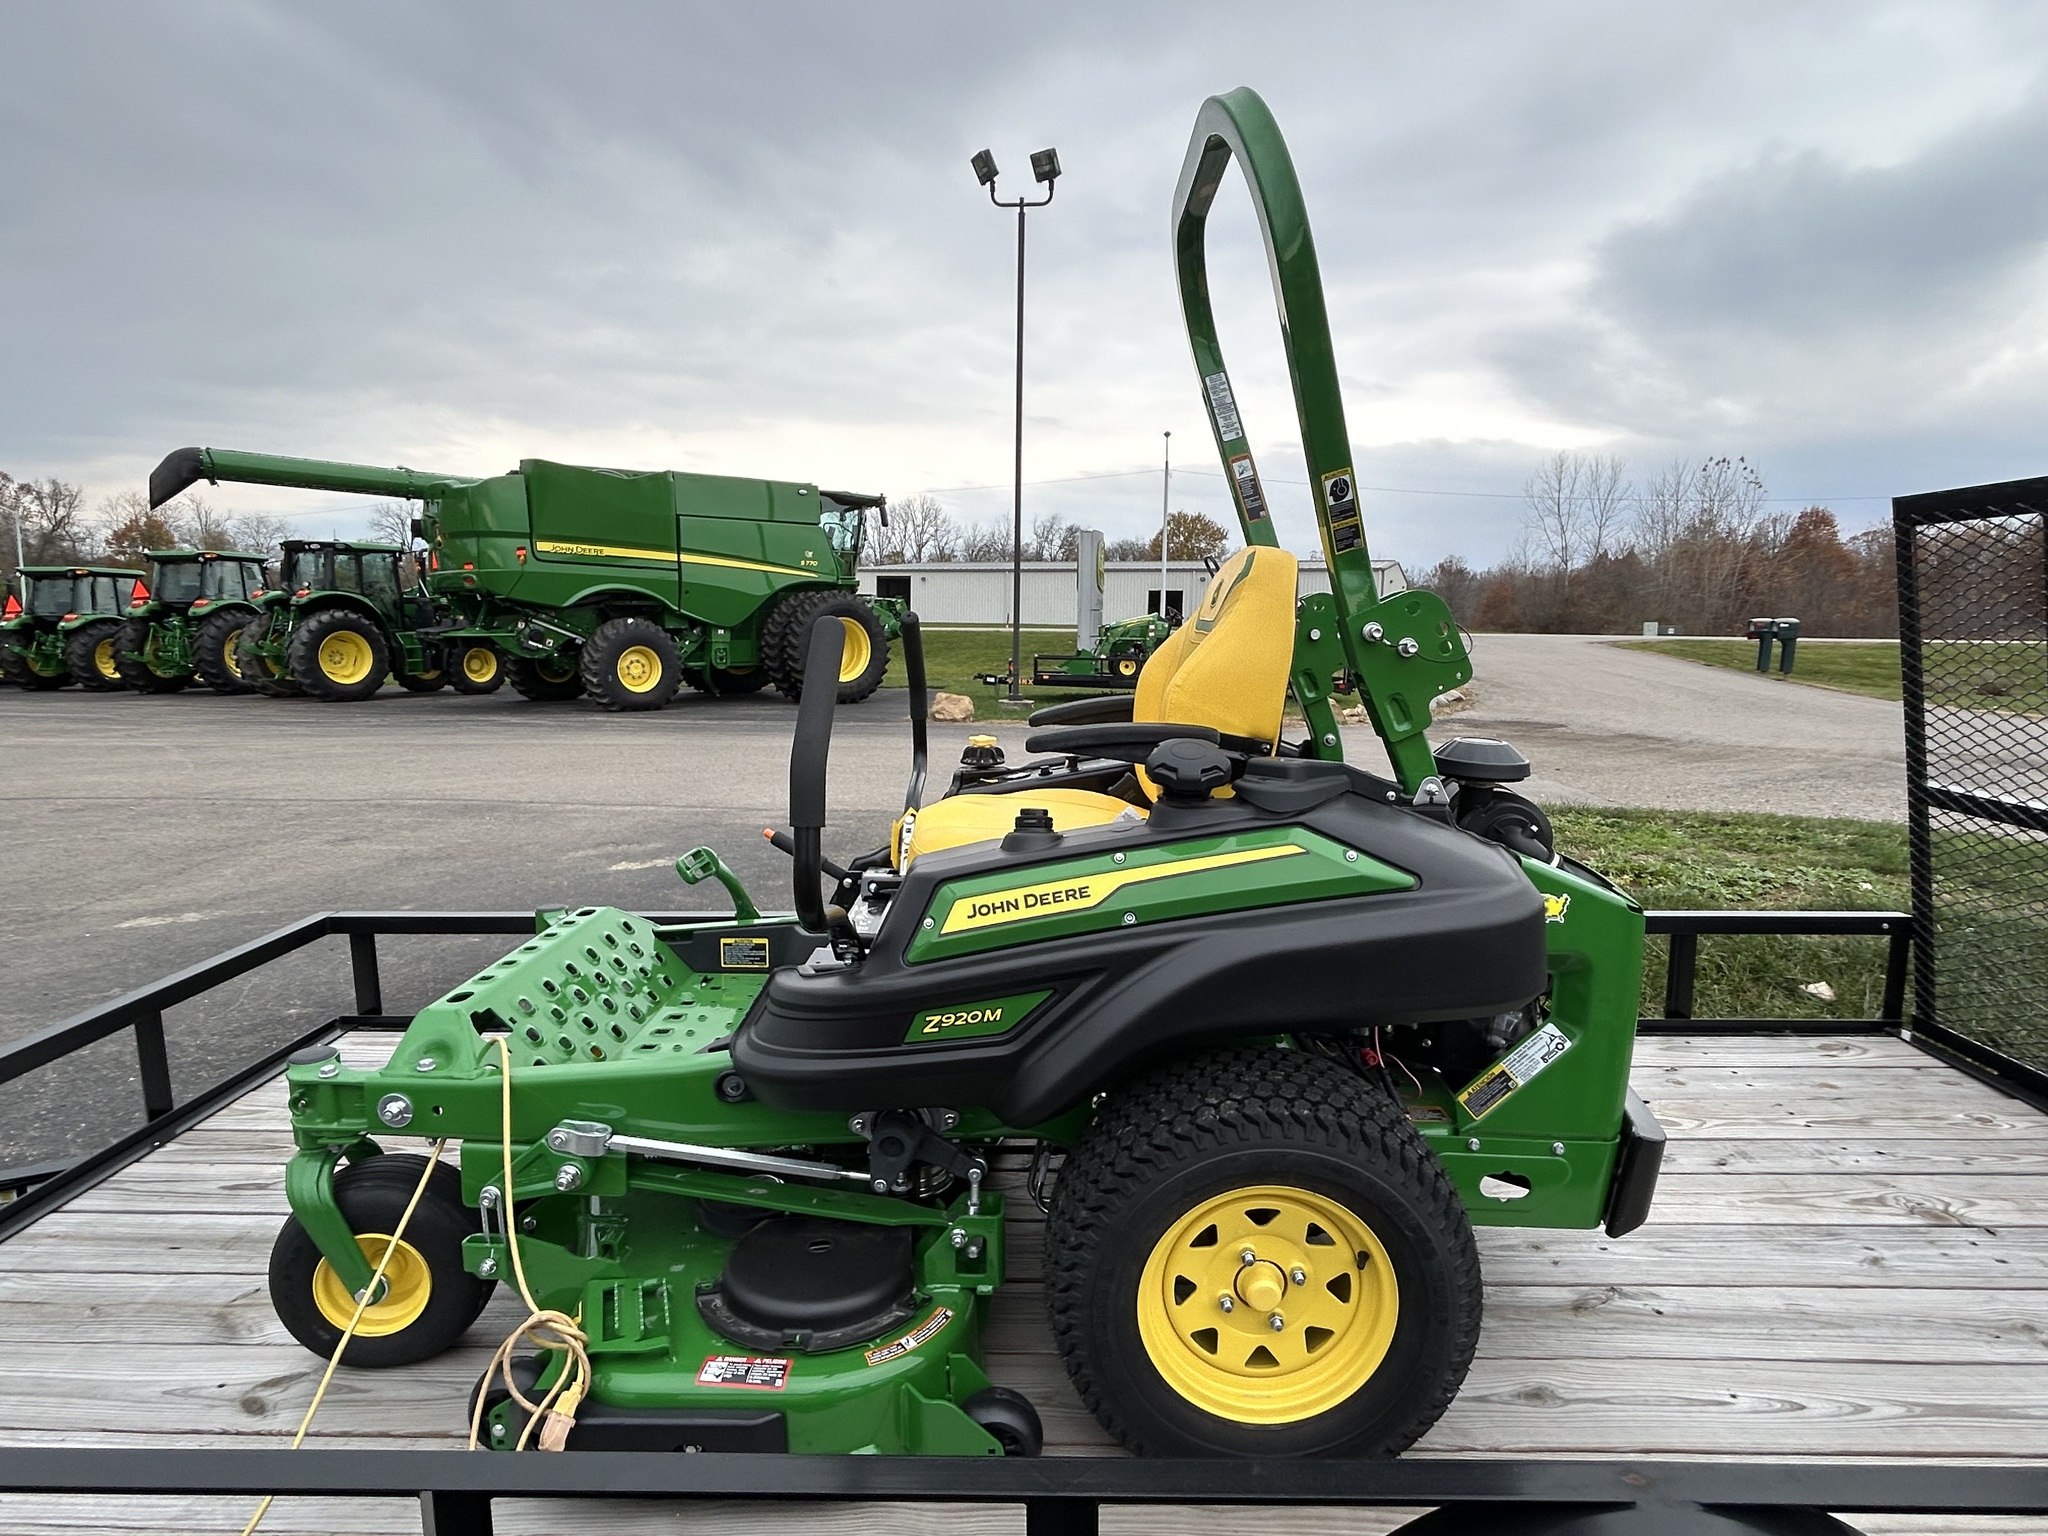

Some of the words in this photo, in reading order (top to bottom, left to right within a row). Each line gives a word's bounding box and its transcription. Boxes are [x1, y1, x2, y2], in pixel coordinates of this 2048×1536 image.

[551, 544, 574, 553] JOHN
[575, 545, 605, 555] DEERE
[967, 898, 1020, 919] JOHN
[1023, 886, 1091, 909] DEERE
[922, 1008, 1003, 1034] Z920M
